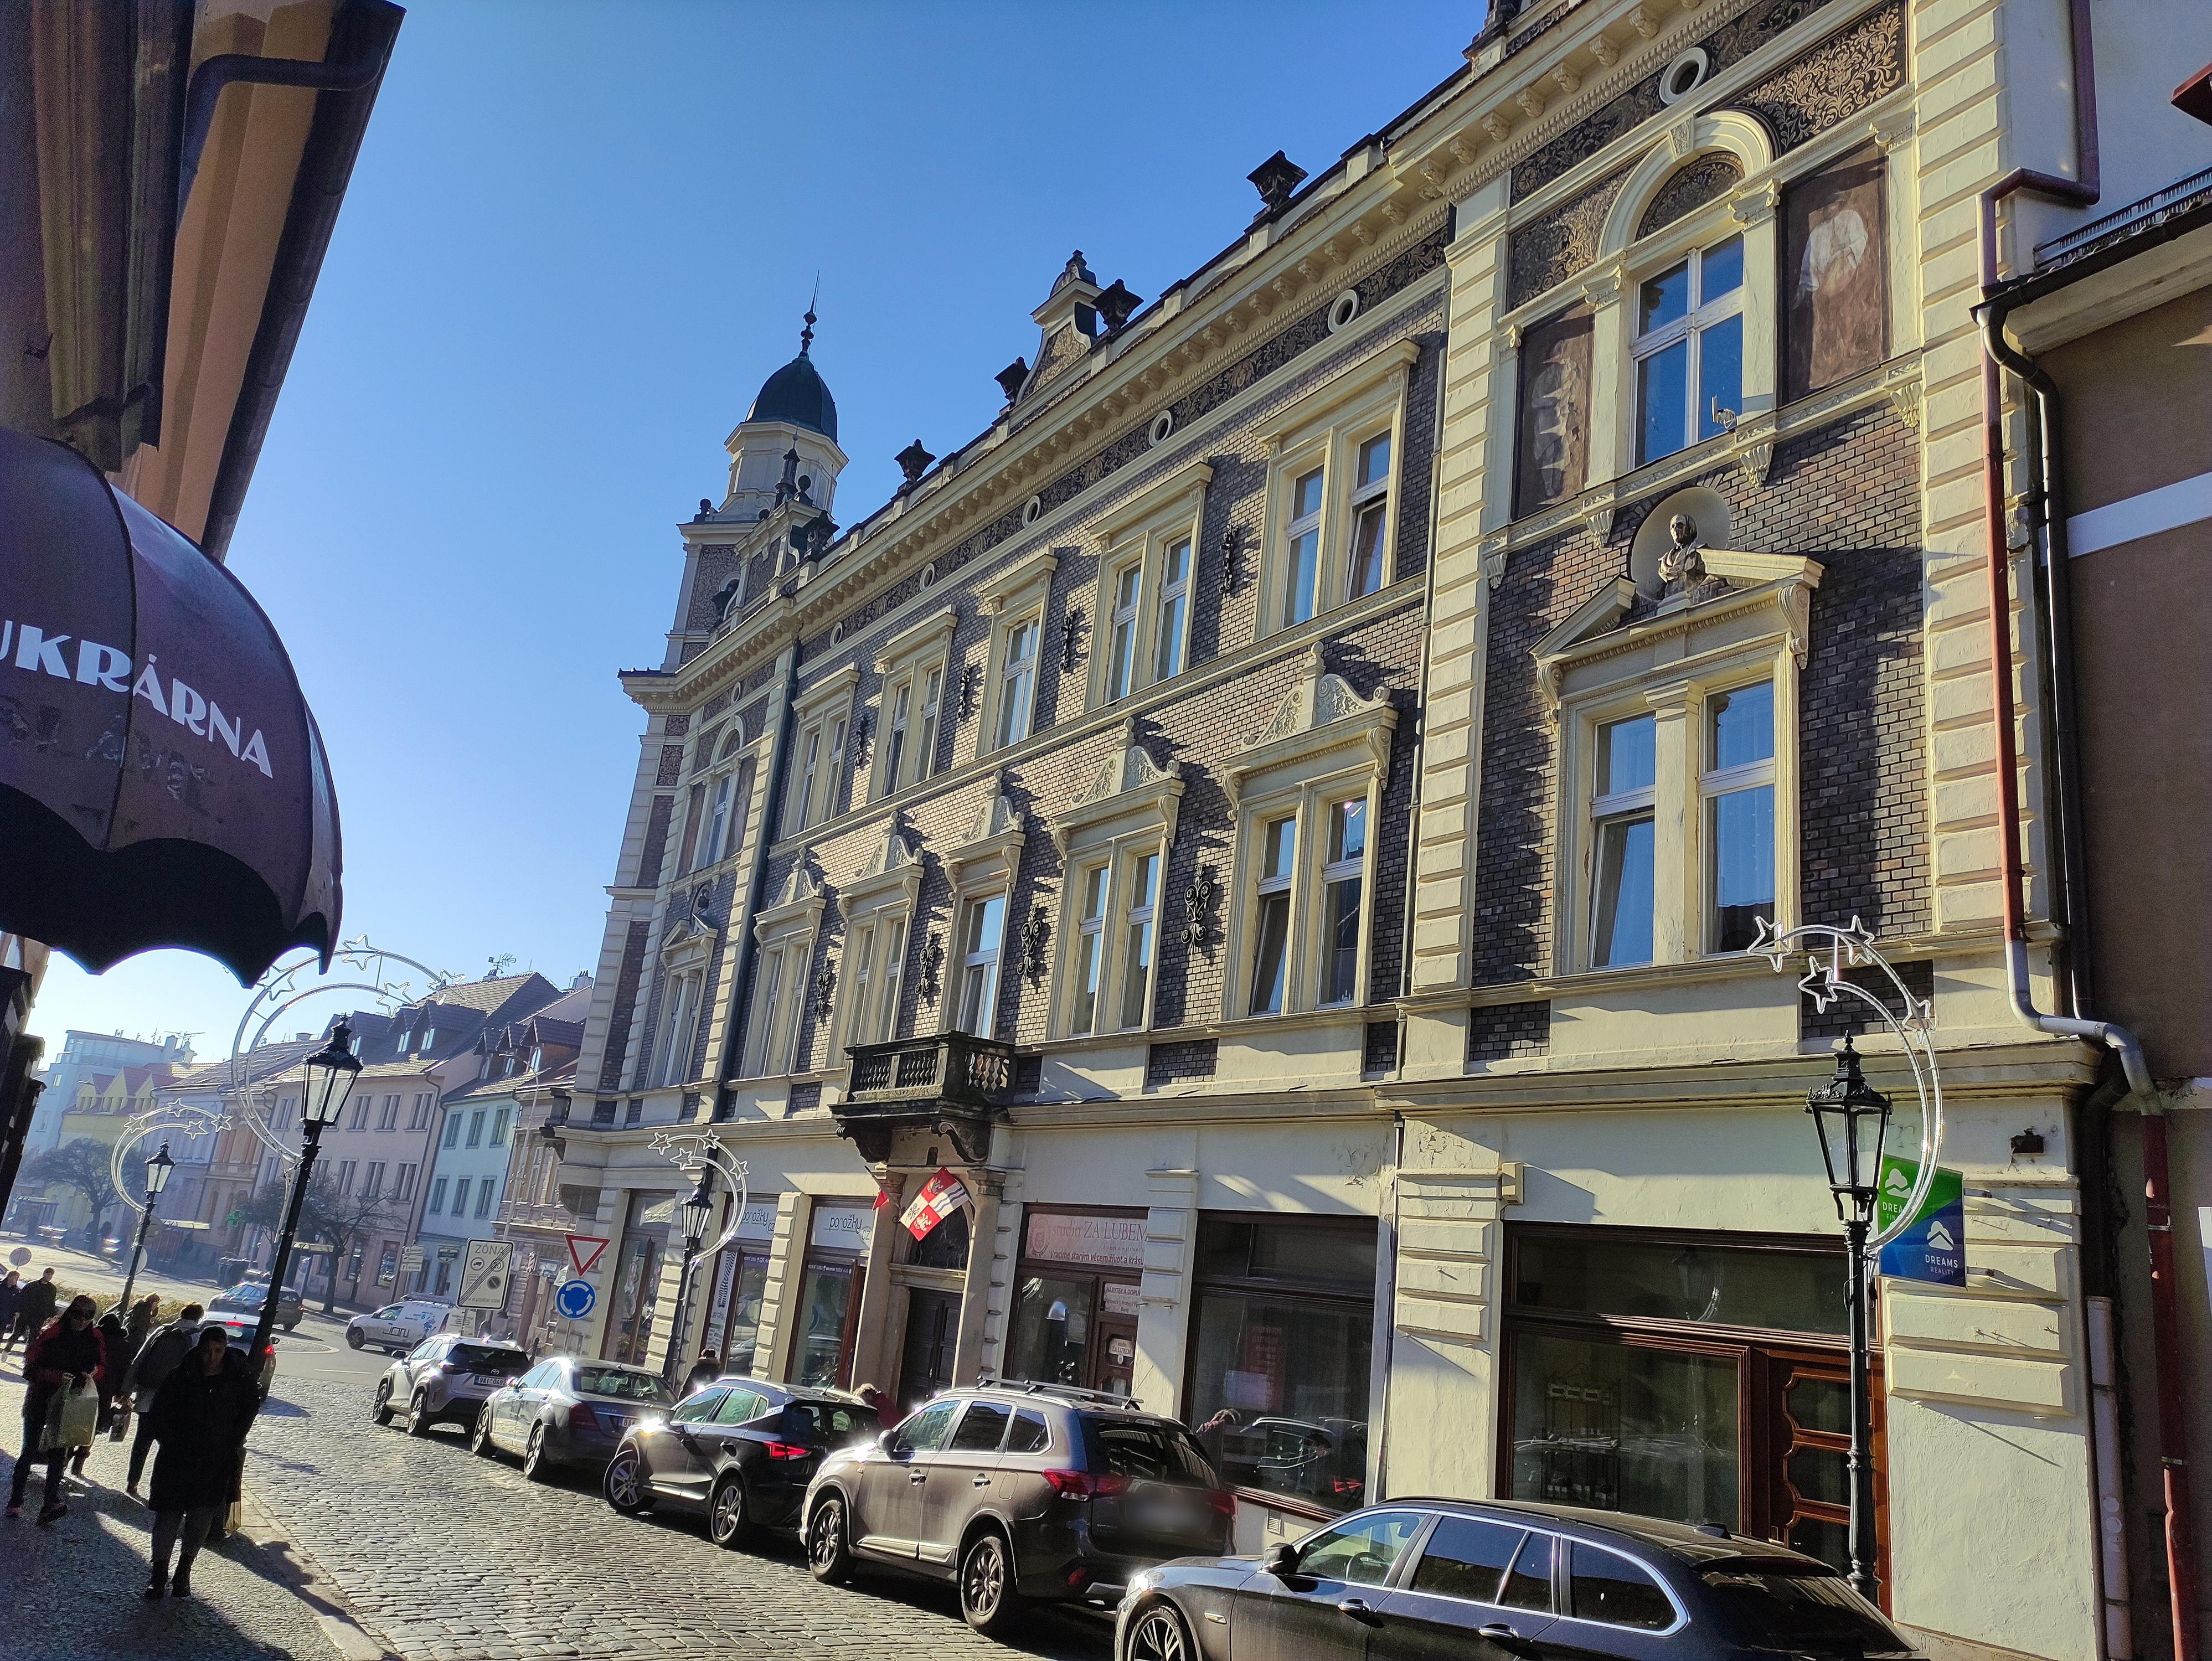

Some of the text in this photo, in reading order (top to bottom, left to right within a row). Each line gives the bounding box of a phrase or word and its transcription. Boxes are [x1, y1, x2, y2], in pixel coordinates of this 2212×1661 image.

[1883, 1201, 1902, 1213] DREA
[1052, 1220, 1081, 1237] studio
[1084, 1221, 1099, 1239] ZA
[1050, 1249, 1070, 1260] Vracíme
[1071, 1252, 1089, 1262] starým
[1090, 1253, 1108, 1262] věcem
[1109, 1254, 1123, 1264] život
[1128, 1255, 1144, 1266] krásu
[1925, 1255, 1958, 1268] DREAMS
[1931, 1266, 1954, 1276] REALITY
